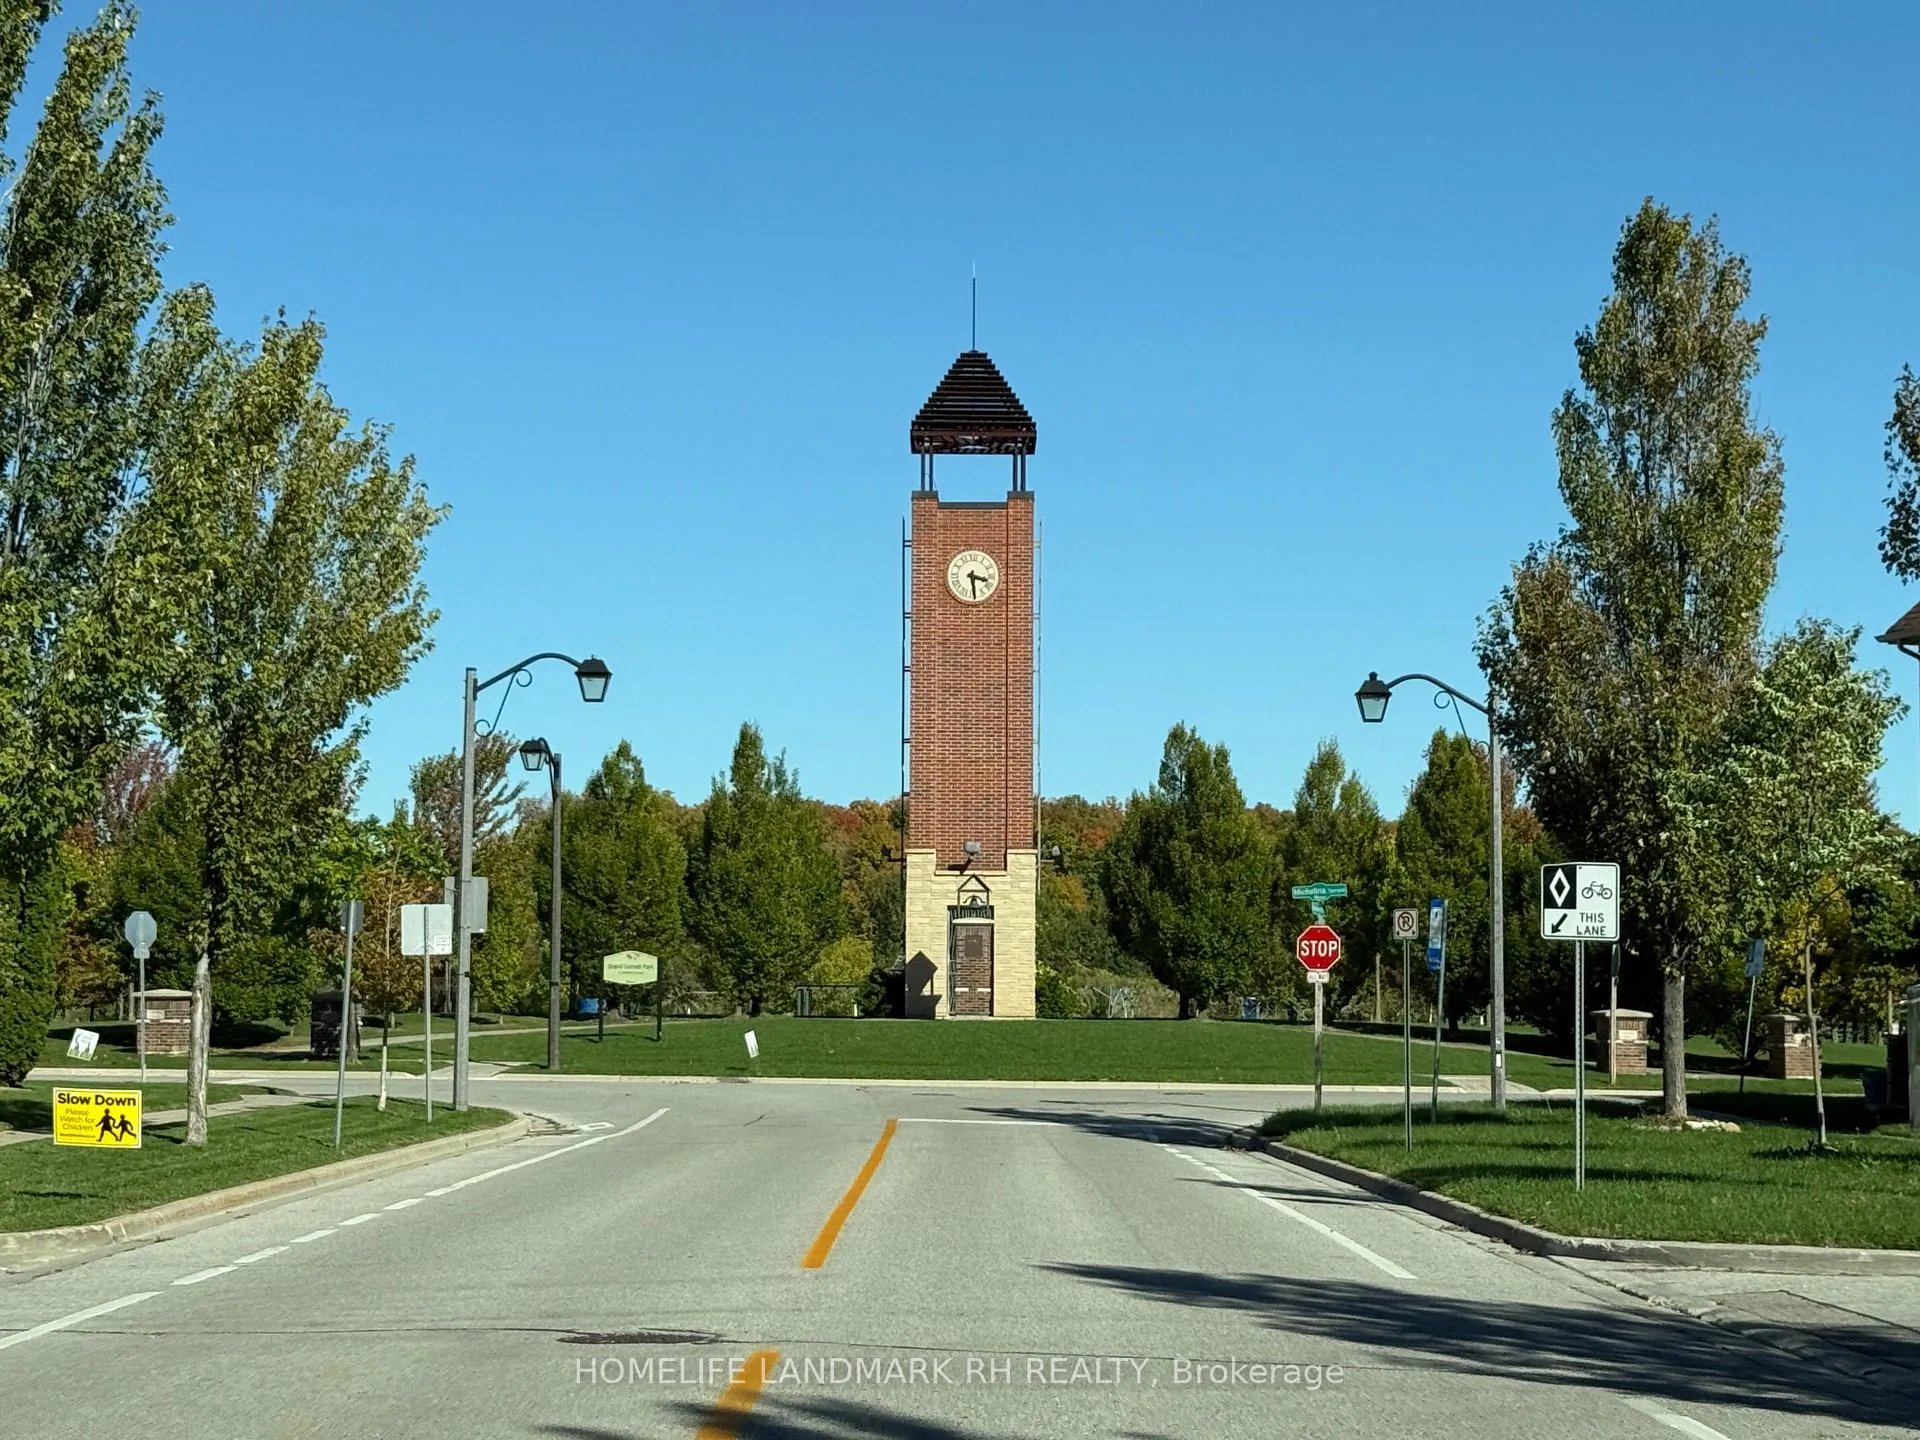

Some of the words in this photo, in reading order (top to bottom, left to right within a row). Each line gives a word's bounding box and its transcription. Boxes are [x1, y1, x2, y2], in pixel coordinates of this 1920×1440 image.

[1579, 912, 1605, 923] THIS
[1576, 925, 1607, 936] LANE
[1300, 940, 1338, 957] STOP
[57, 1092, 91, 1105] Slow
[94, 1094, 137, 1107] Down
[65, 1108, 90, 1116] Please
[59, 1115, 84, 1124] Watch
[62, 1122, 94, 1132] Children
